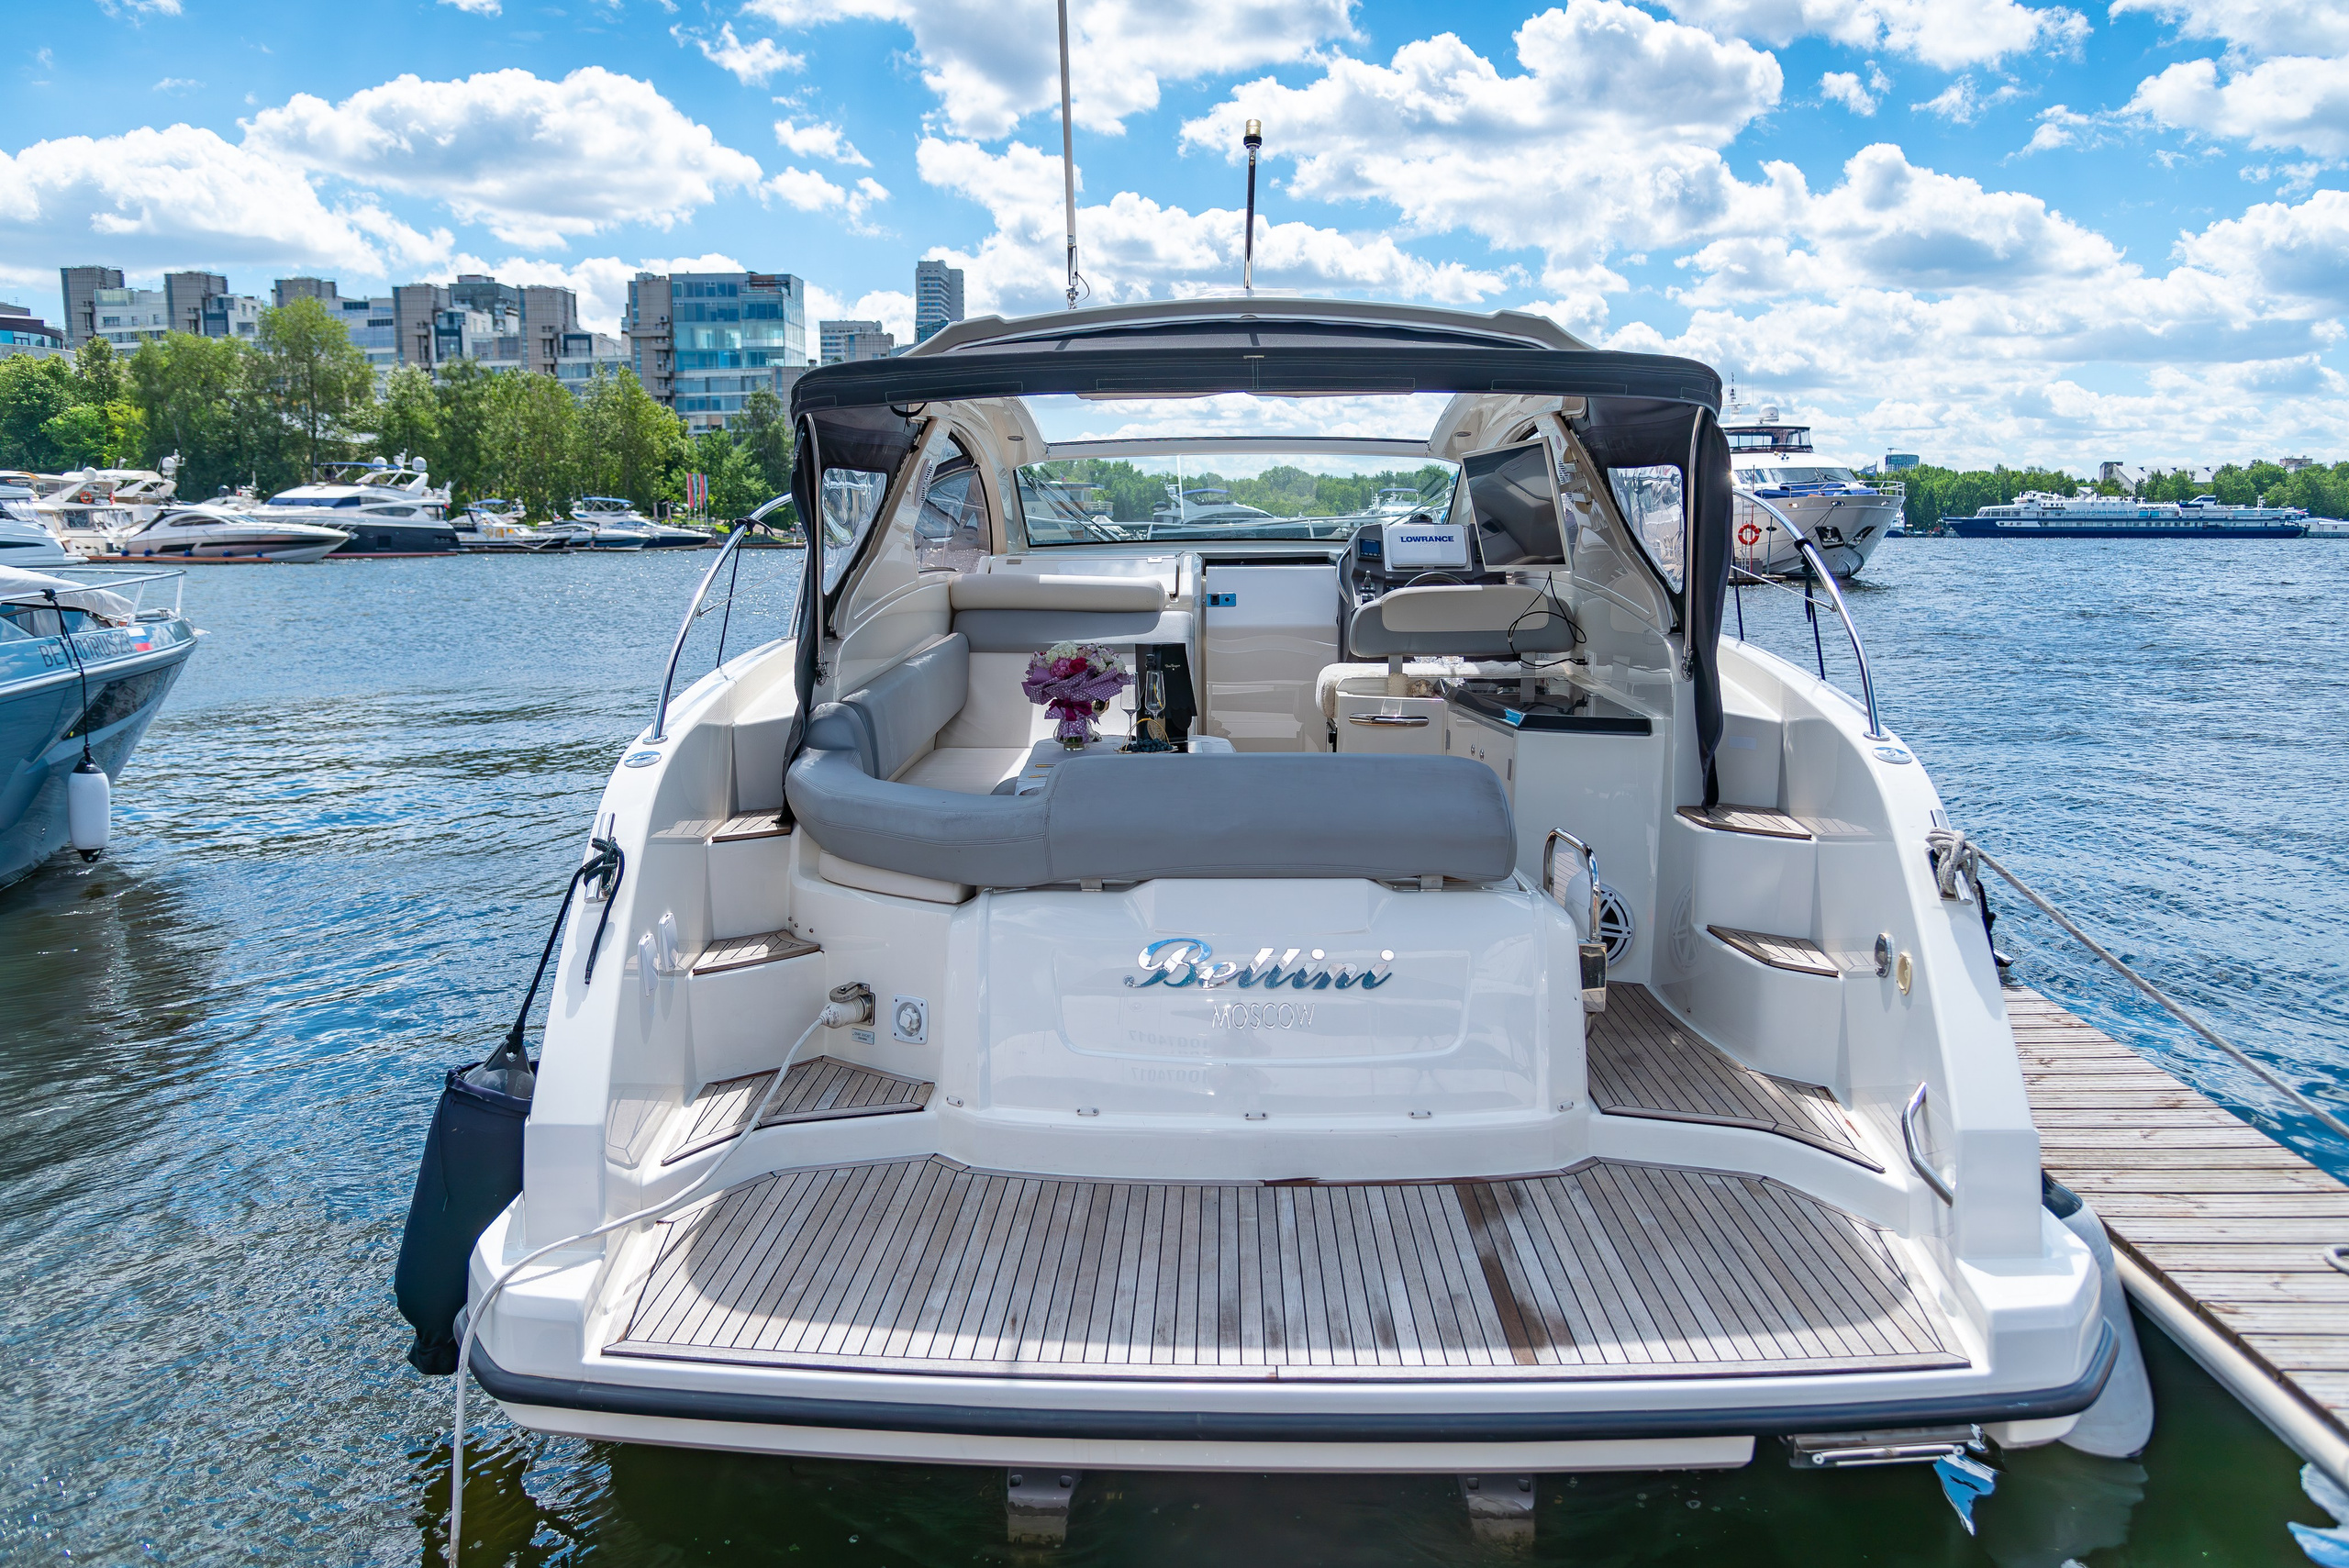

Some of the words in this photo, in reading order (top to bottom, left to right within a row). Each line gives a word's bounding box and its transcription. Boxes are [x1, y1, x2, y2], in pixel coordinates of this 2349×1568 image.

[1400, 535, 1454, 543] LOWRANCE
[1123, 938, 1395, 989] Bellini
[1211, 1002, 1316, 1029] MOSCOW
